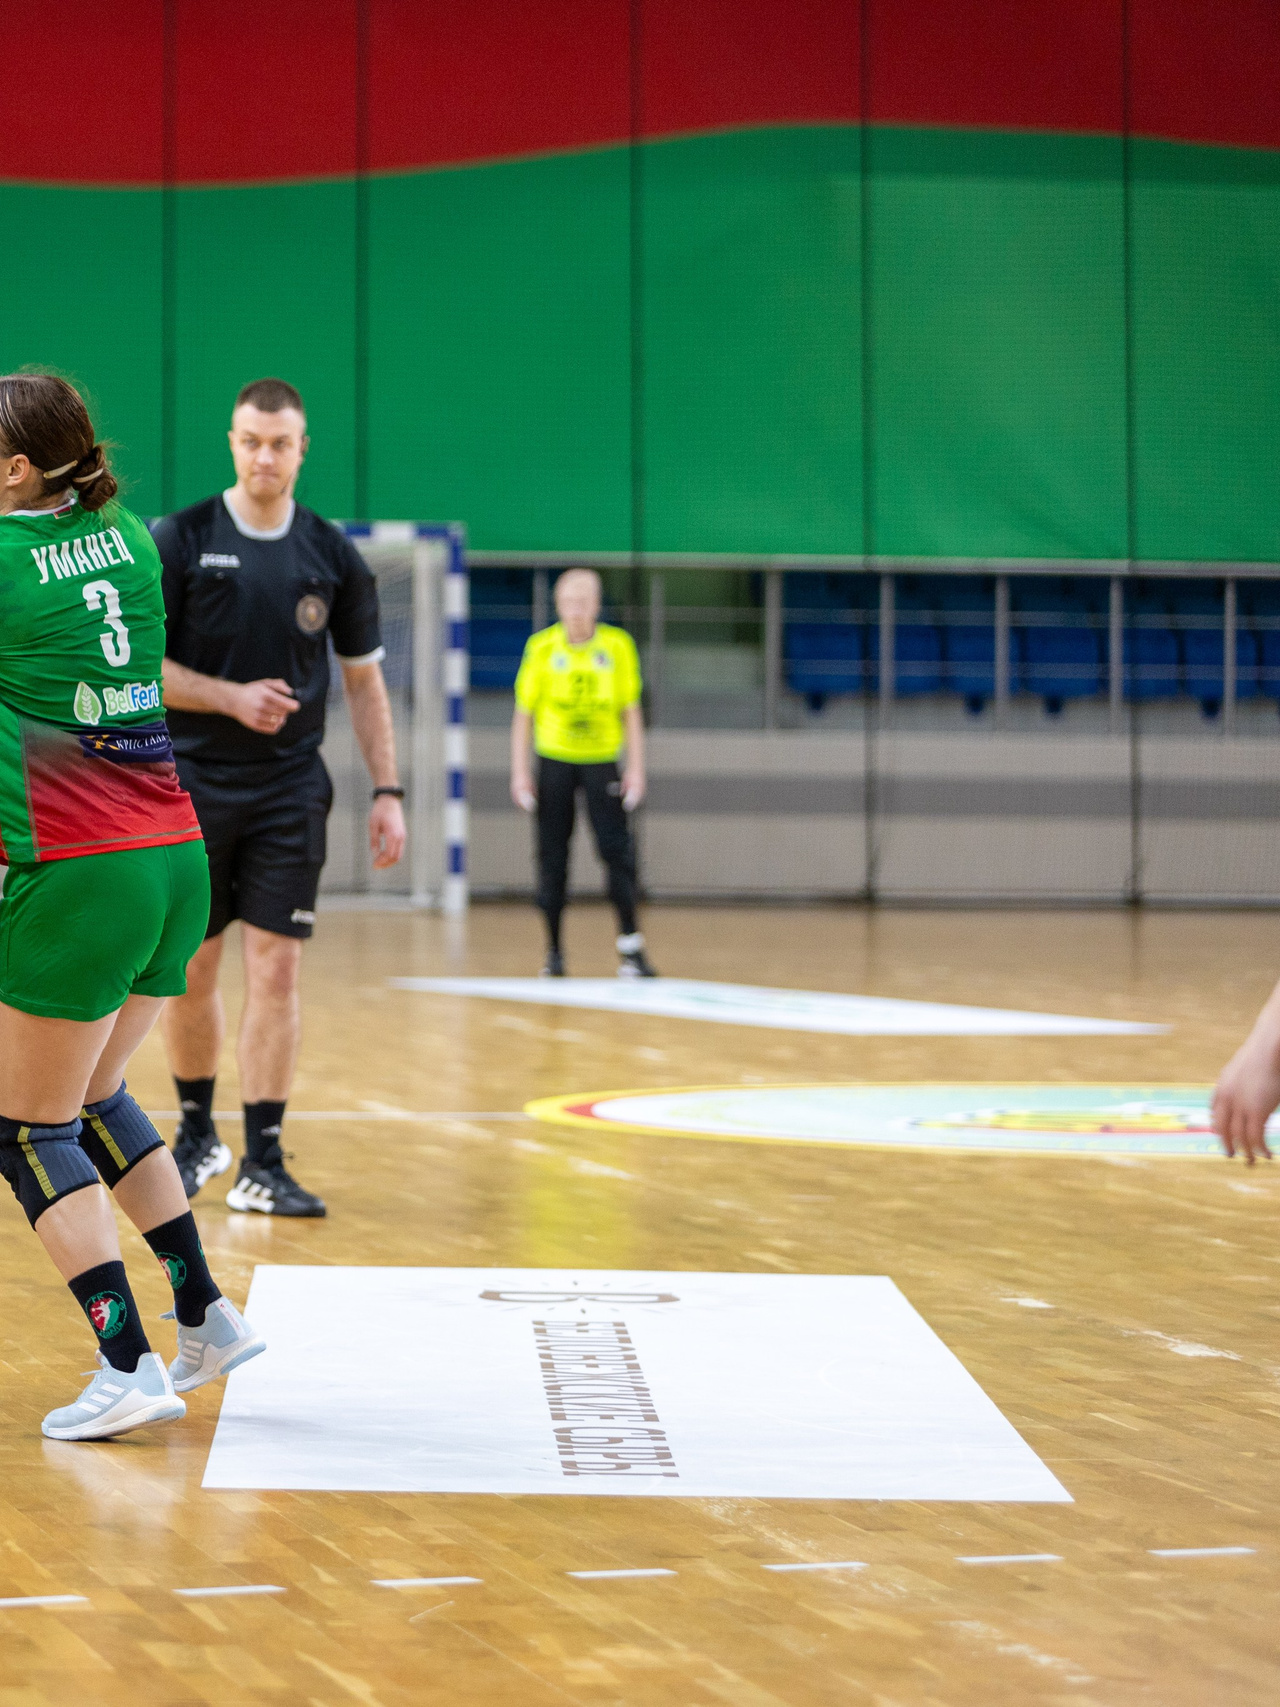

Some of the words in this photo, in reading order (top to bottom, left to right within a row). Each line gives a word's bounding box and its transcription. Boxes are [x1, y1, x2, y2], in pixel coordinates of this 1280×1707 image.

[30, 526, 135, 585] УМАНЕЦ
[82, 579, 131, 668] 3
[104, 681, 160, 716] BelFert
[532, 1320, 661, 1423] БЕЛОВЕЖСКИЕ
[552, 1426, 681, 1478] СЫРЫ
